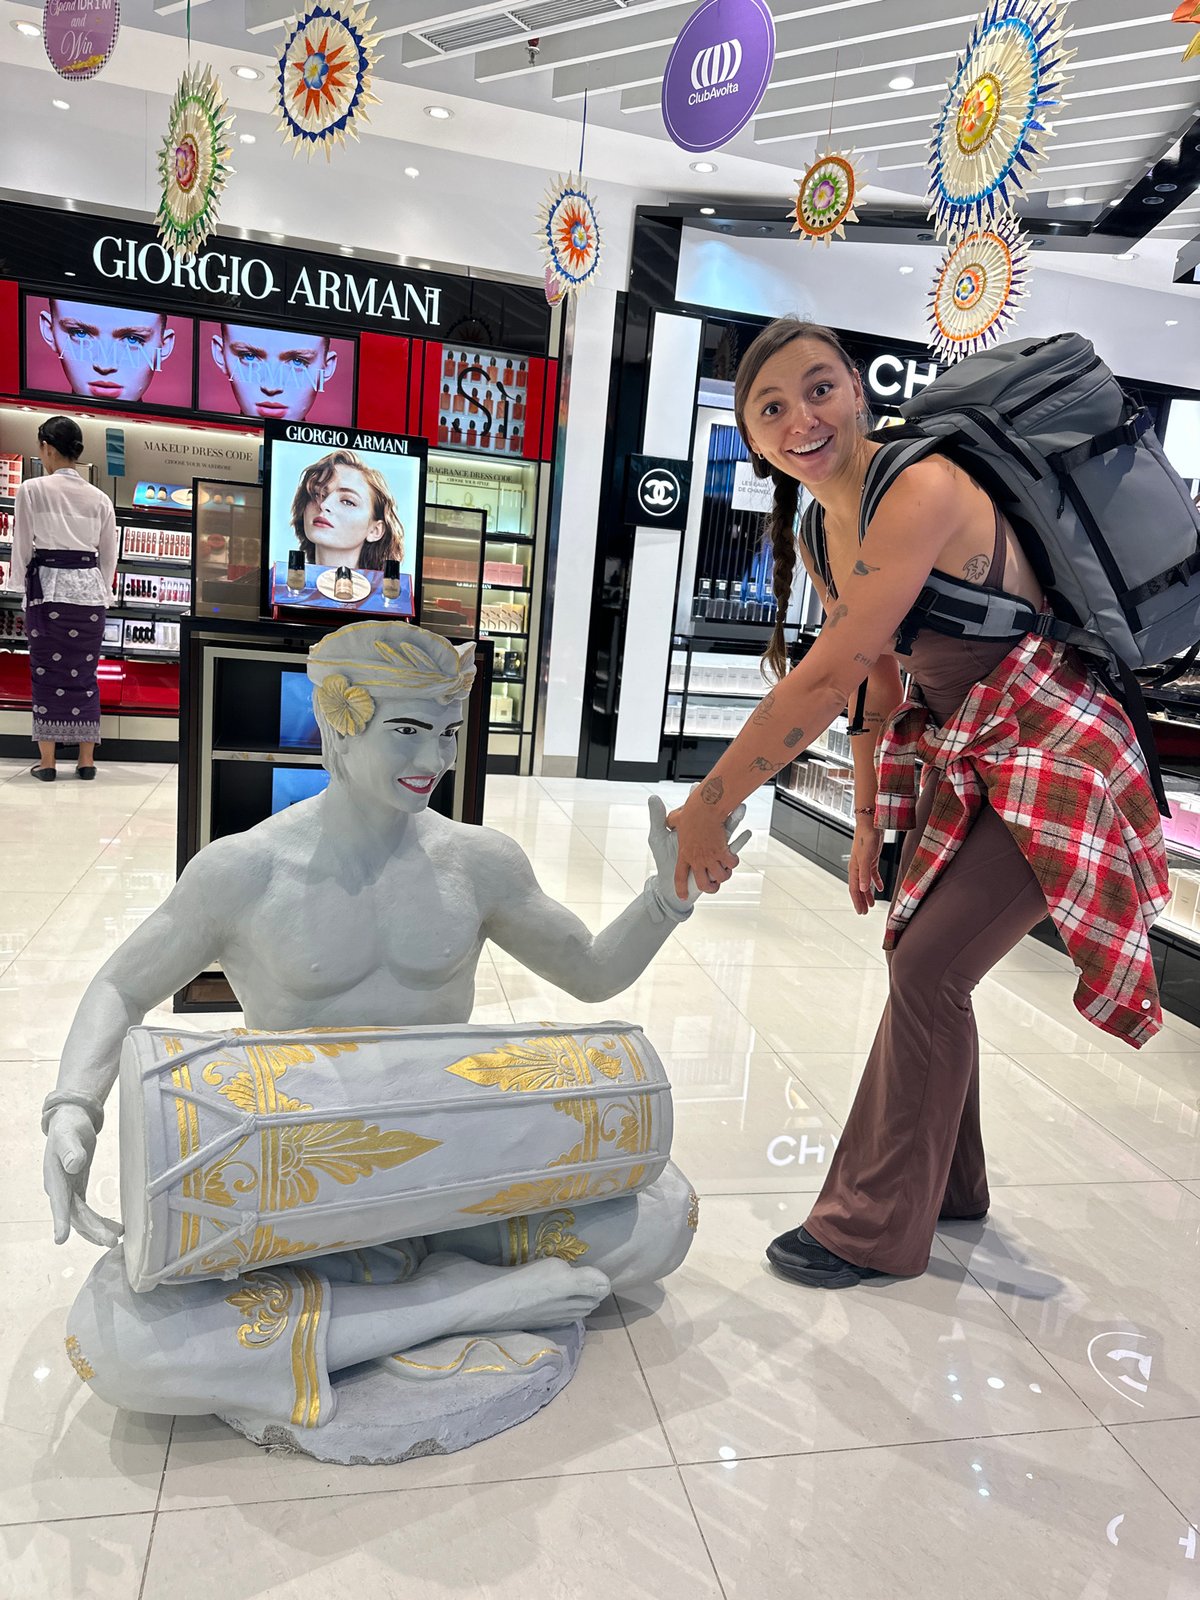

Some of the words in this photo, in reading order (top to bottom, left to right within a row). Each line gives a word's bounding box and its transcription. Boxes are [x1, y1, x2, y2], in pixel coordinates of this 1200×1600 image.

[70, 13, 87, 27] and
[60, 29, 94, 61] Win
[688, 82, 739, 106] ClubAvolta
[93, 236, 274, 299] GIORGIO
[288, 267, 442, 325] ARMANI
[58, 336, 163, 372] ARMANI
[228, 358, 325, 393] ARMANI
[144, 441, 189, 454] MAKEUP
[192, 446, 223, 458] DRESS
[225, 450, 253, 462] CODE
[286, 425, 349, 446] GIORGIO
[353, 434, 409, 454] ARMANI
[428, 466, 468, 477] RAGRANCE
[470, 470, 493, 480] DRESS
